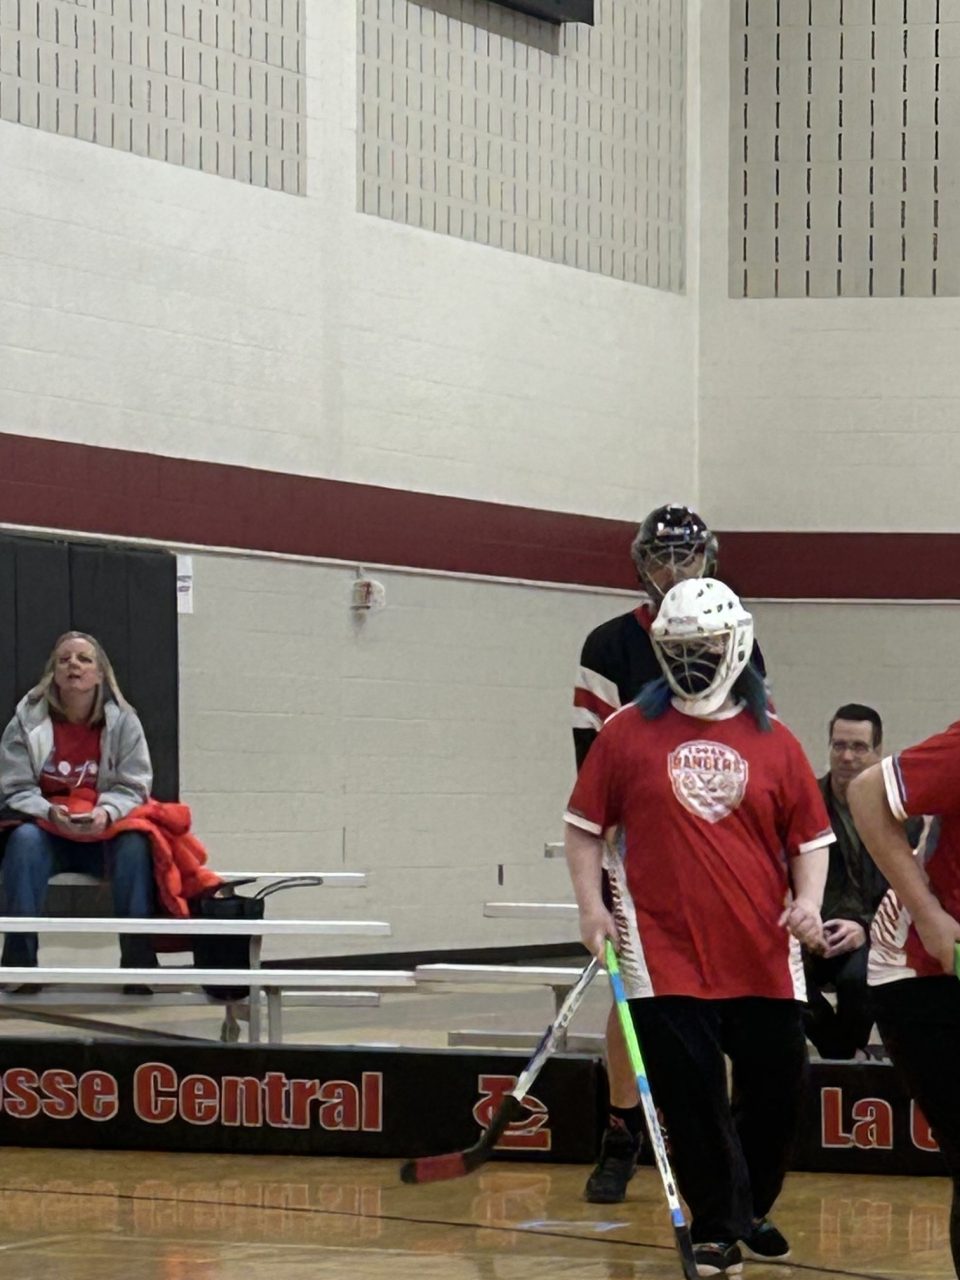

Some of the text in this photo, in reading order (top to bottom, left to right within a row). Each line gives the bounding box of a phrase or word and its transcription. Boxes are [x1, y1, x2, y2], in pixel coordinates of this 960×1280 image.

[673, 754, 743, 774] RANGERS
[0, 1061, 383, 1132] sse Central
[820, 1087, 893, 1149] La
